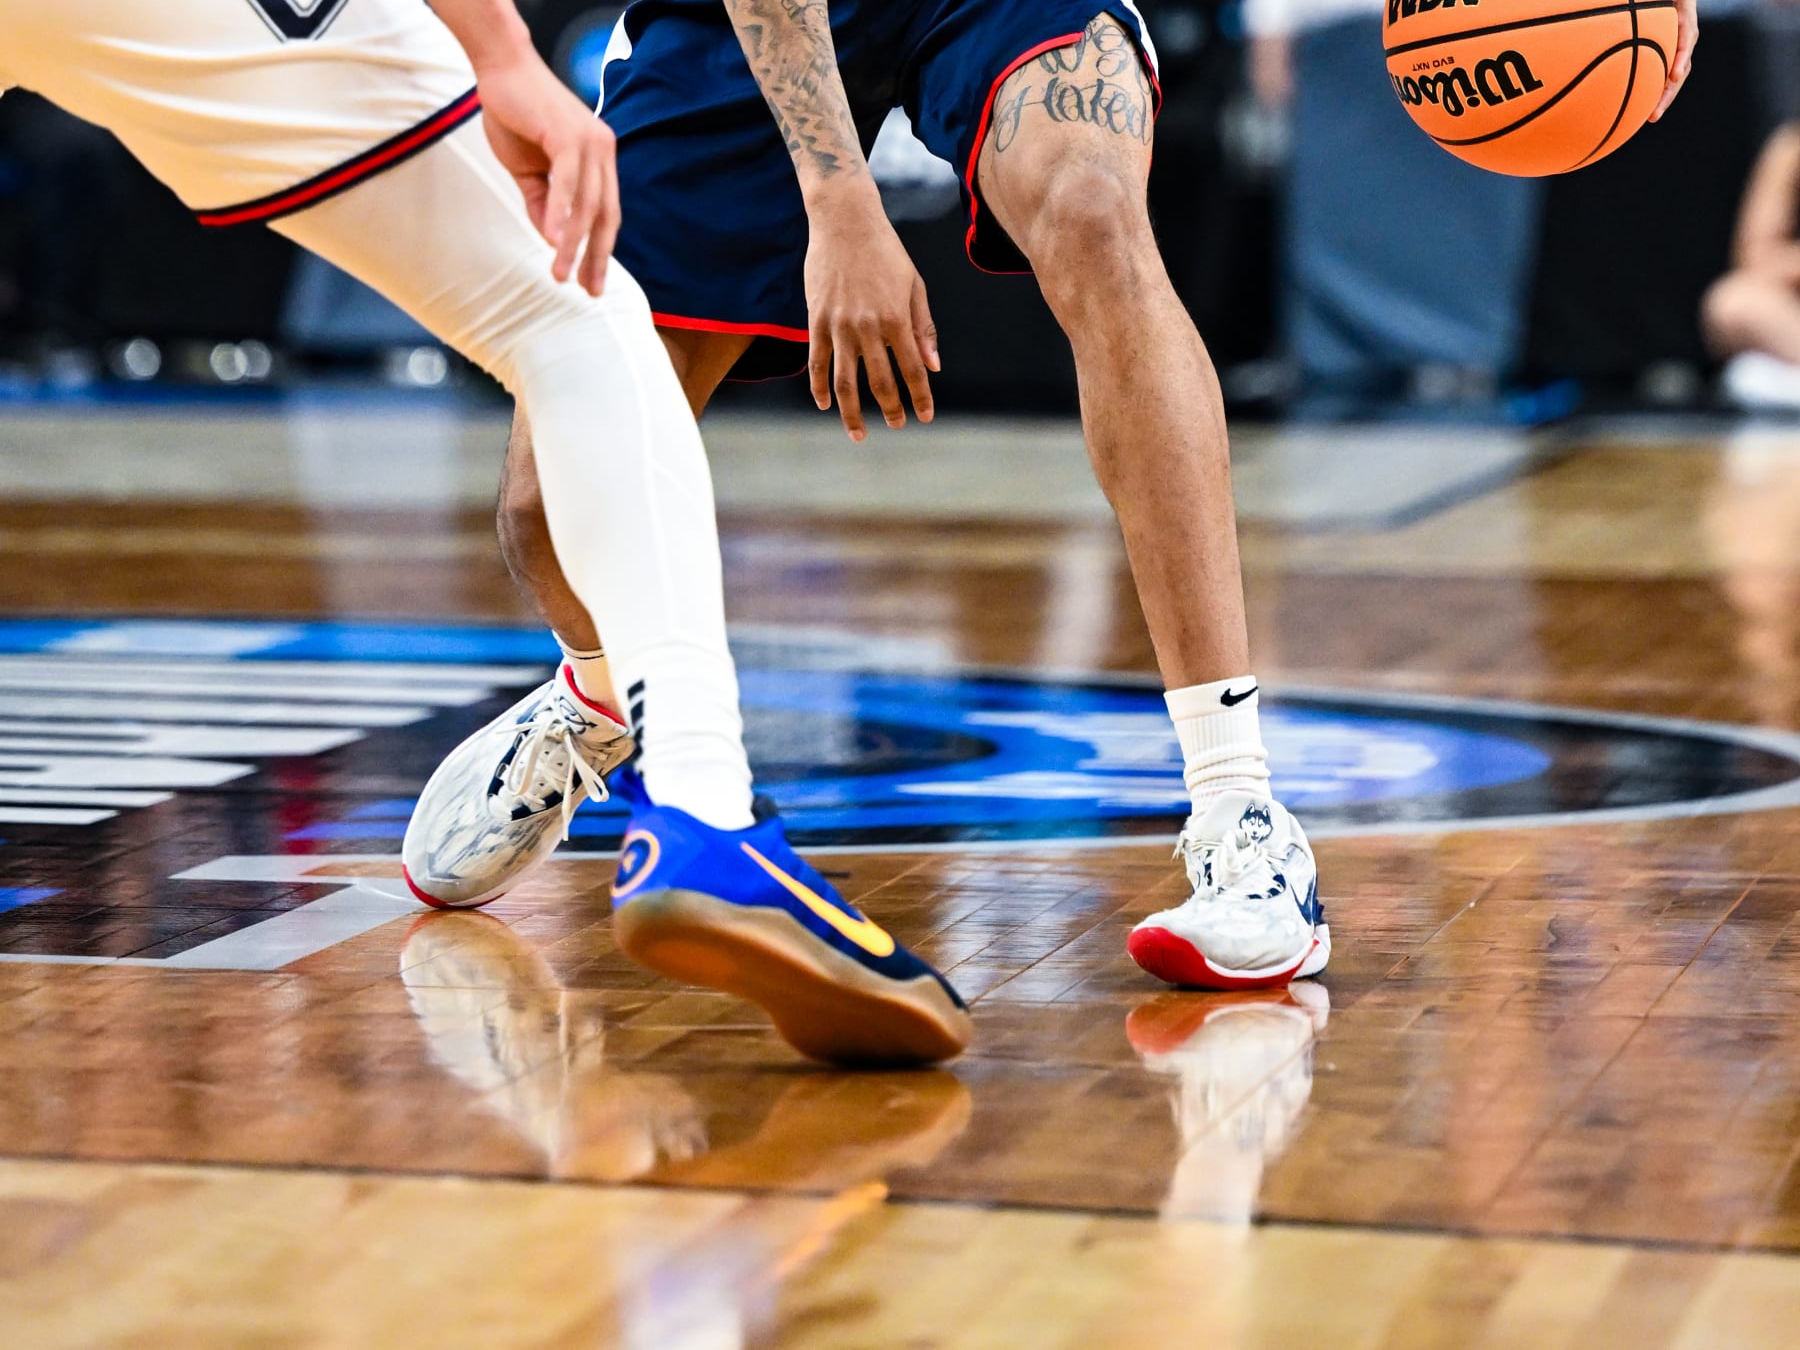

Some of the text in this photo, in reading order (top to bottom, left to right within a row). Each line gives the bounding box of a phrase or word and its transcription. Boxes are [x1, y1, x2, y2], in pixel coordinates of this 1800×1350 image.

[1389, 49, 1545, 118] Wilson
[1411, 55, 1455, 72] EVO NXT
